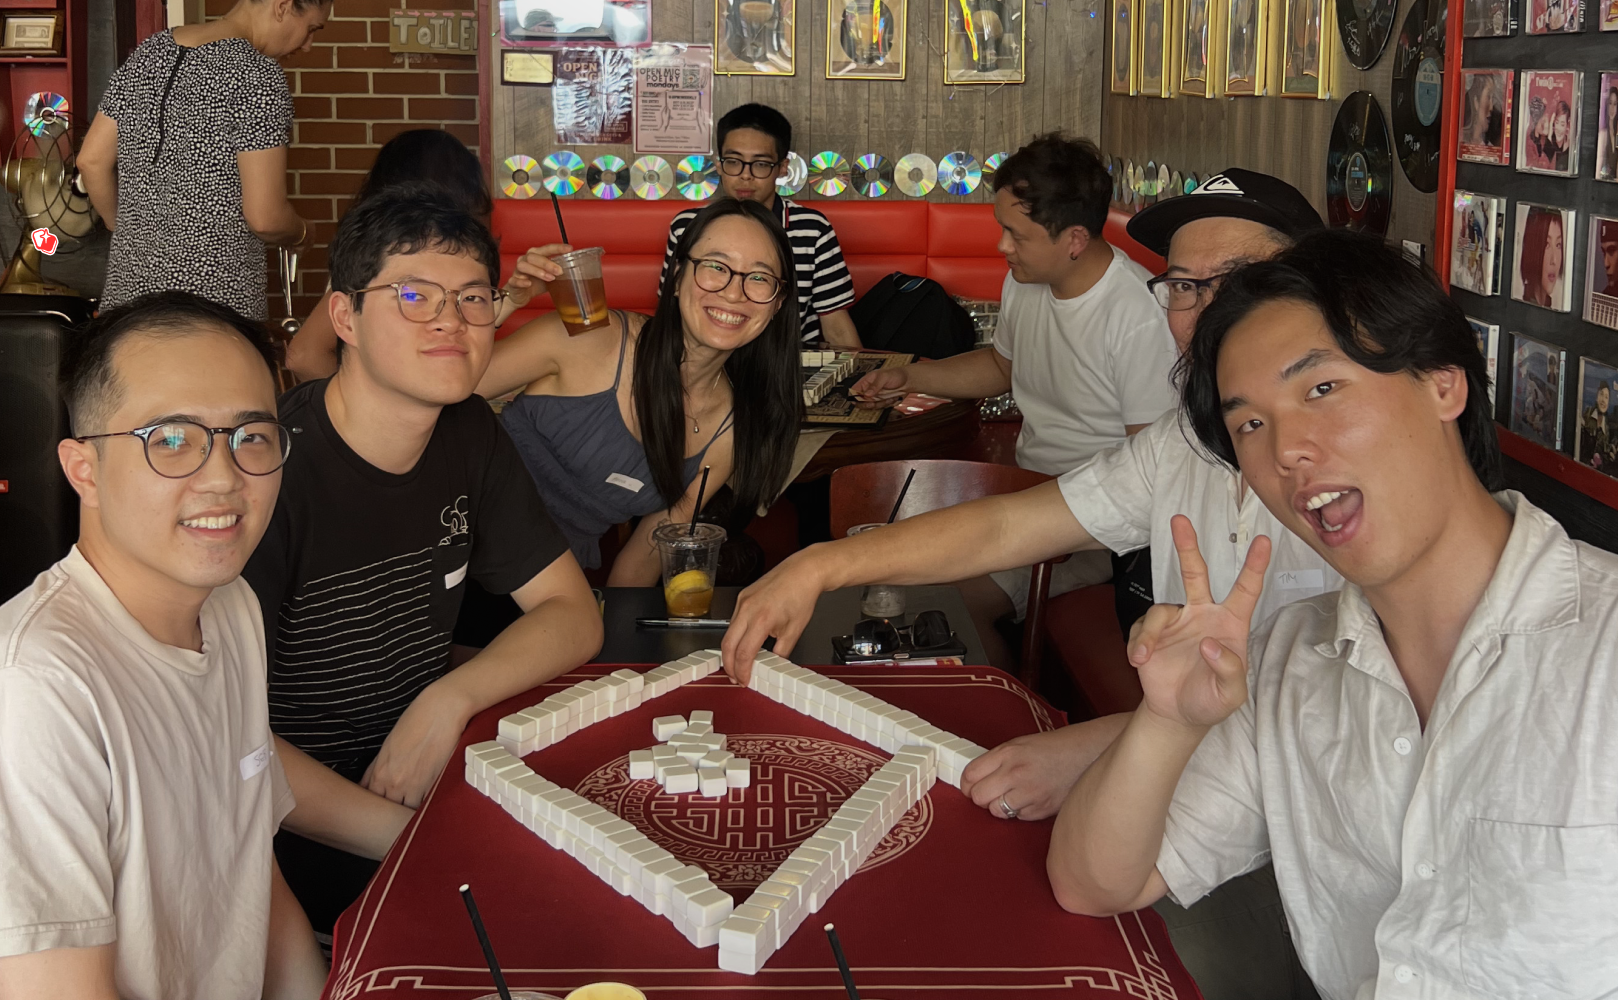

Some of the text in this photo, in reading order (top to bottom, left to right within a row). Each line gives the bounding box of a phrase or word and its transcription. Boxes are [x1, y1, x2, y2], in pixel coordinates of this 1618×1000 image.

[563, 62, 598, 72] OPEN
[664, 68, 680, 76] MIC
[646, 74, 680, 82] POETRY
[646, 80, 680, 90] mondays
[1278, 572, 1298, 584] TIM
